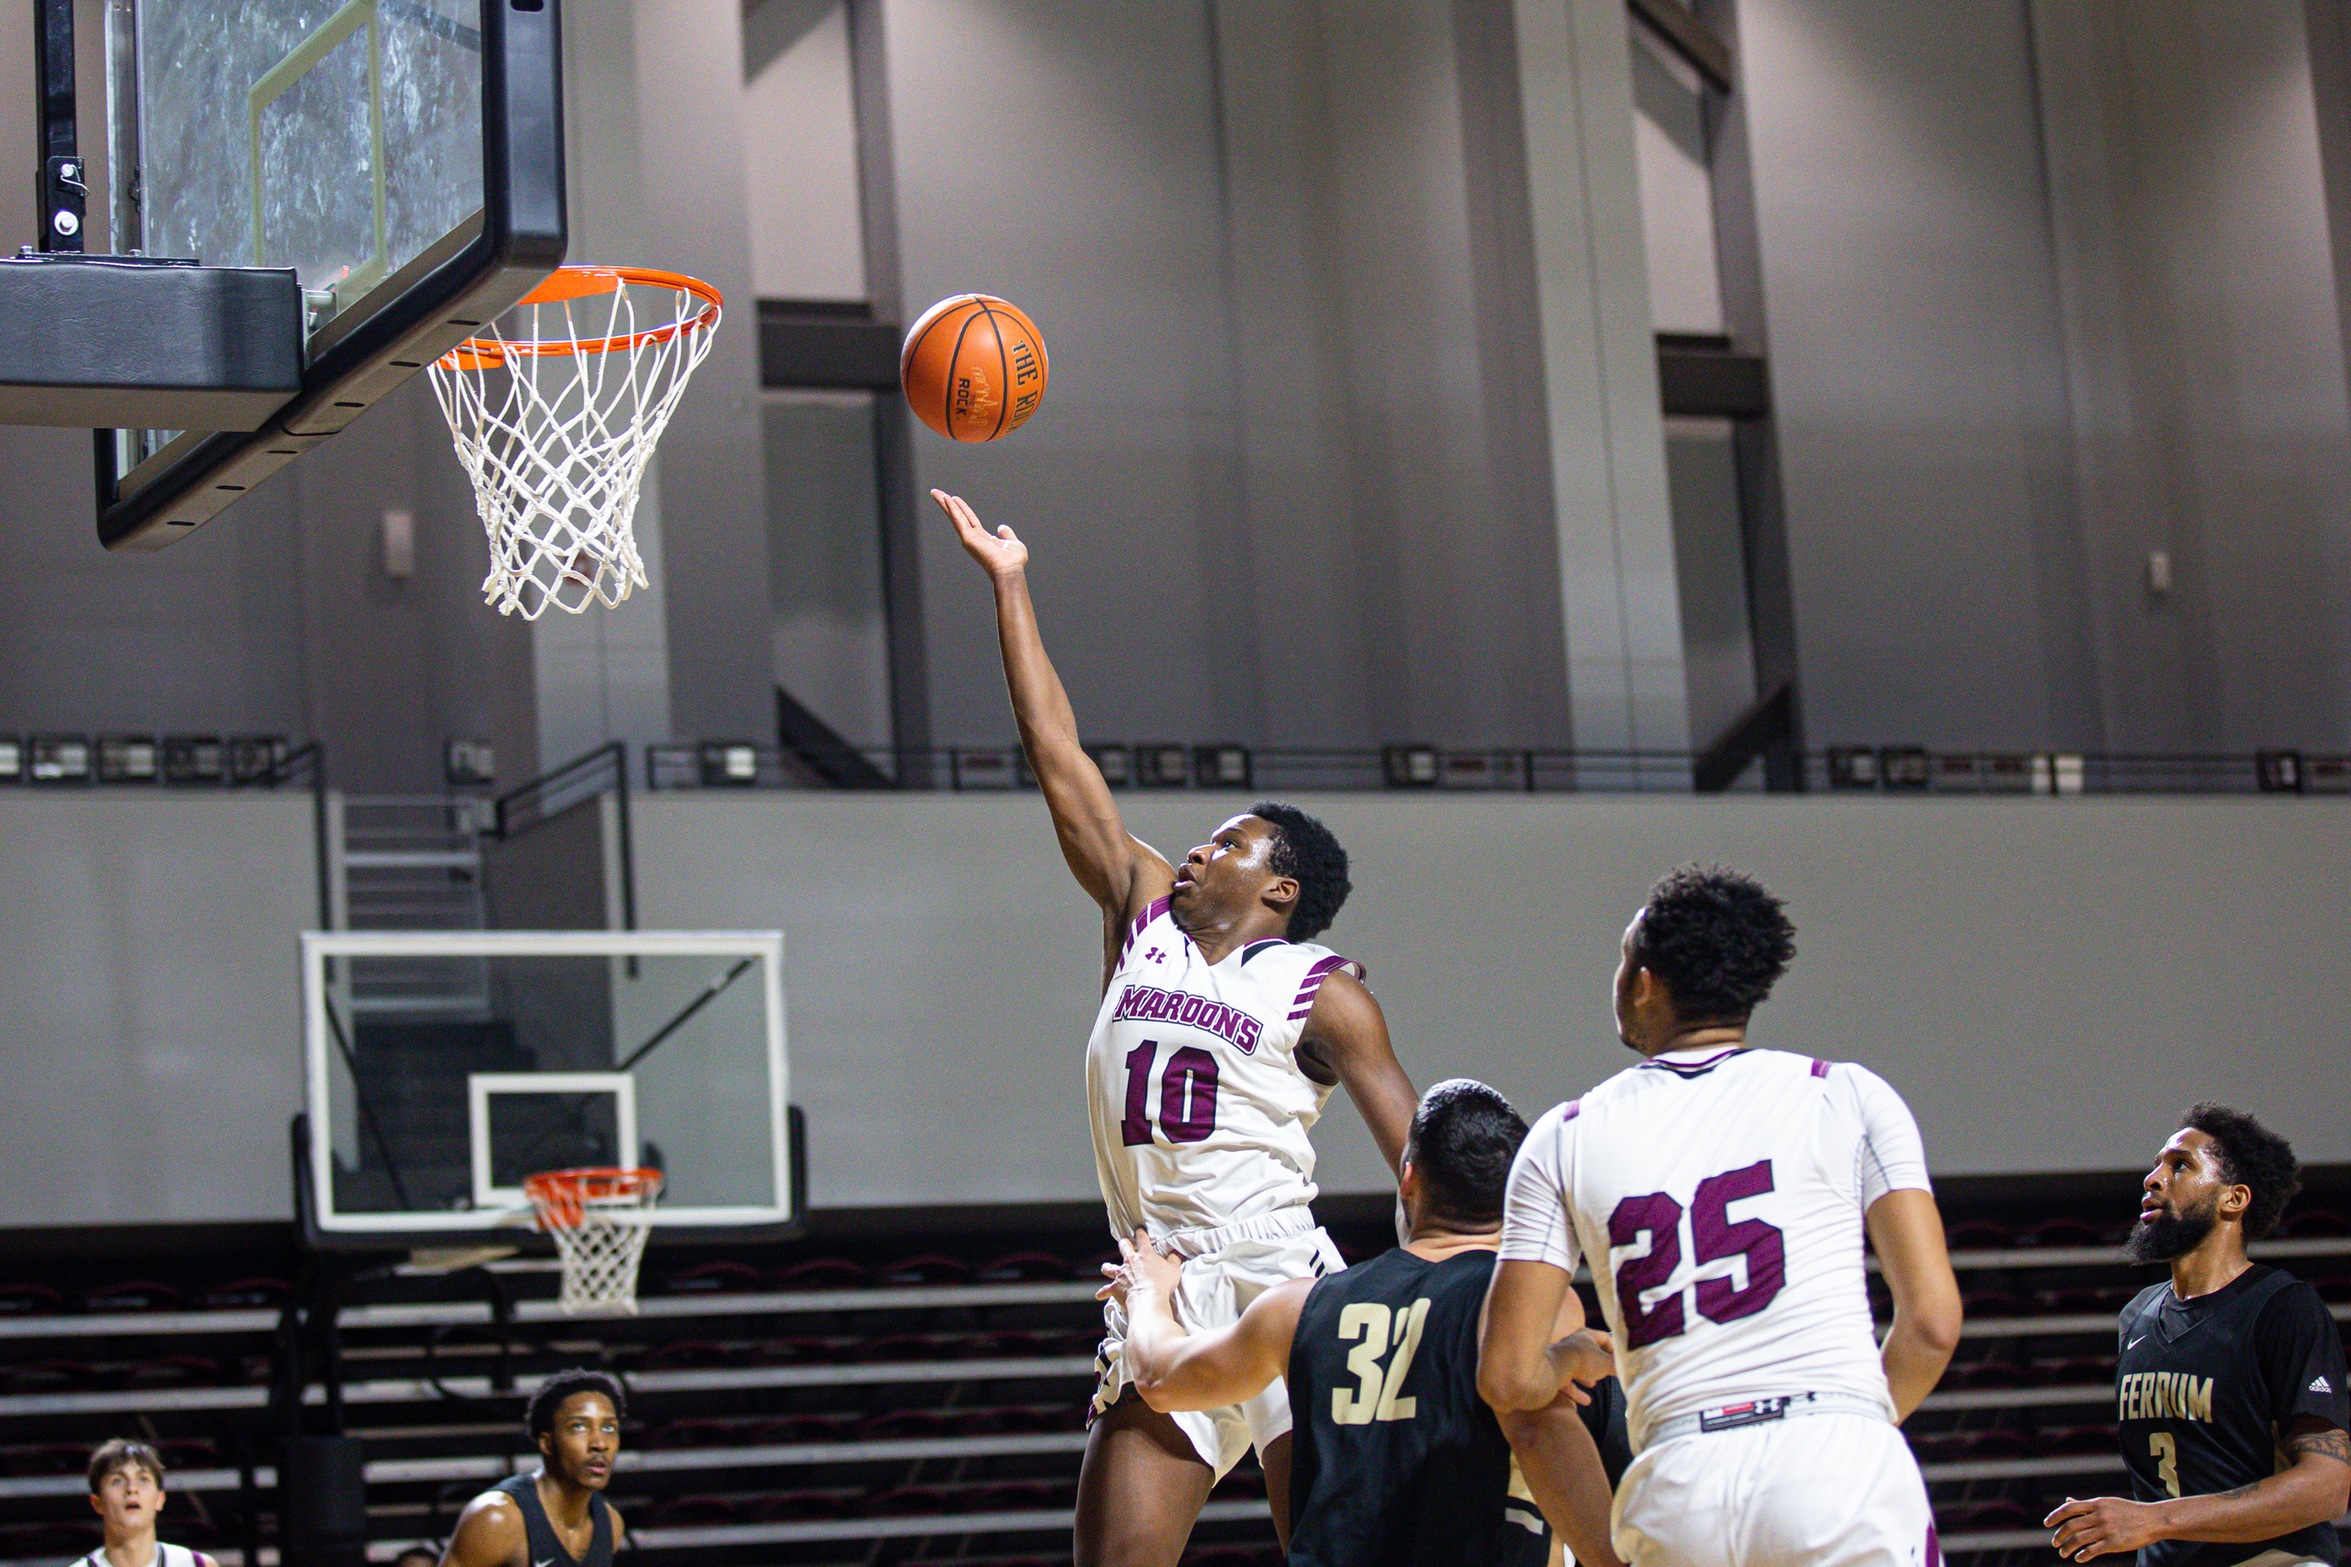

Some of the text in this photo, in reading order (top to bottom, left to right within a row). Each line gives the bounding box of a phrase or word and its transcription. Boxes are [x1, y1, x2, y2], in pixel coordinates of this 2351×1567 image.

[1012, 340, 1039, 386] THE
[956, 378, 970, 417] ROCK
[1113, 985, 1263, 1056] MAROONS
[1121, 1039, 1219, 1146] 10
[1608, 1159, 1785, 1350] 25
[1332, 1298, 1431, 1424] 32
[2120, 1372, 2213, 1424] FERRUM
[2149, 1432, 2180, 1498] 3
